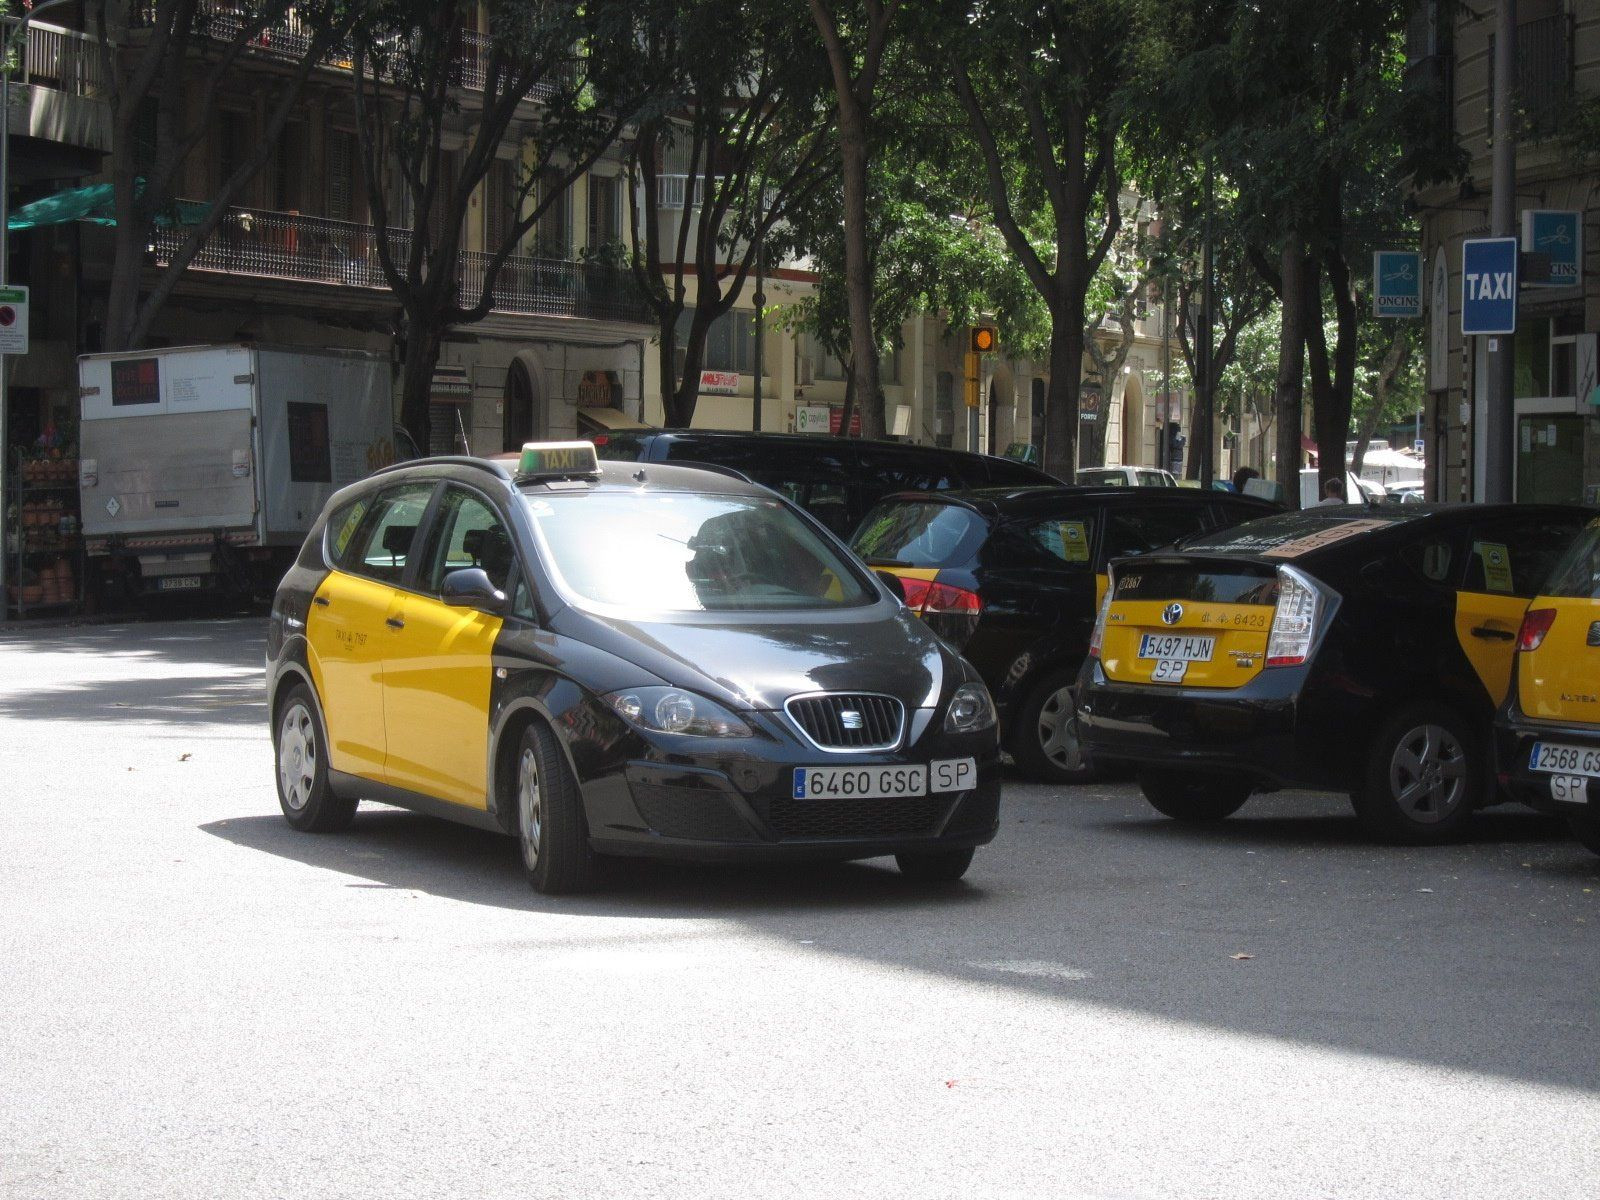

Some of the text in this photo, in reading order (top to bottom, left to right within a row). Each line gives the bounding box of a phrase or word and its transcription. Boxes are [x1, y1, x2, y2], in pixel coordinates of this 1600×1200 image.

[1466, 273, 1512, 300] TAXI
[1378, 296, 1419, 306] ONCINS
[543, 449, 575, 469] TAXI
[1234, 614, 1265, 627] 6423
[1147, 638, 1211, 658] 5497 HJN
[1156, 660, 1183, 679] SP
[1540, 746, 1579, 770] 2568
[810, 770, 921, 796] 6460 GSC
[938, 762, 969, 788] SP
[1555, 775, 1582, 799] SP
